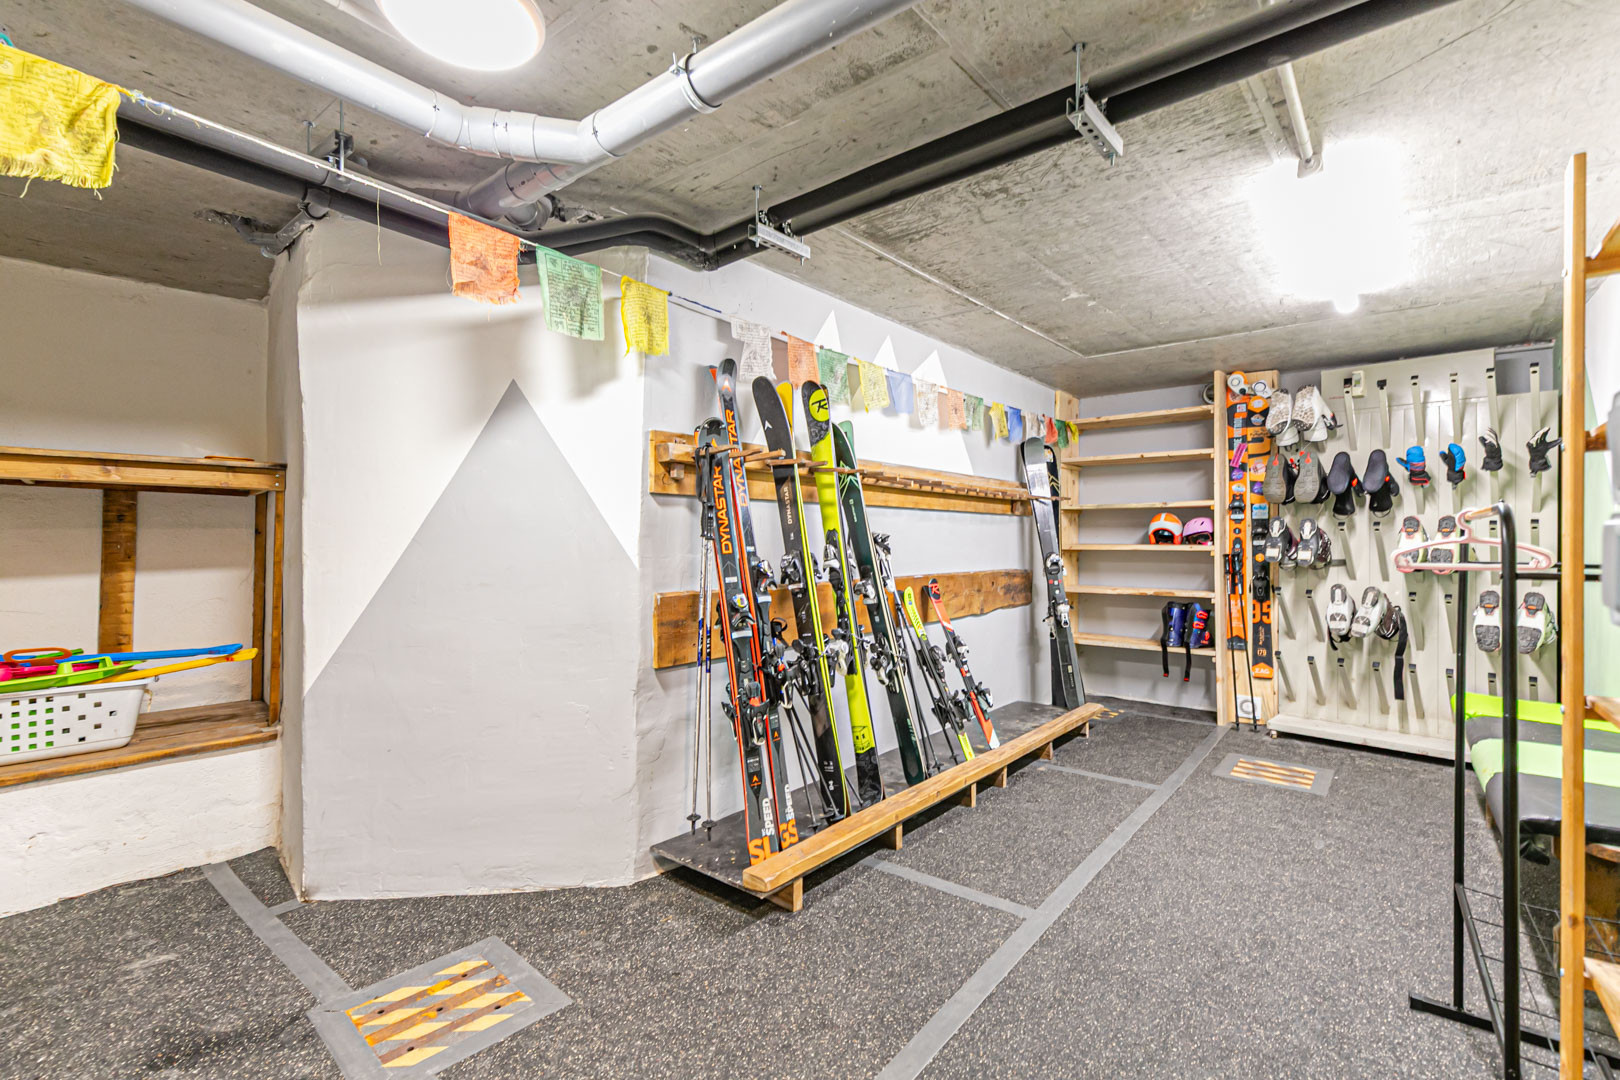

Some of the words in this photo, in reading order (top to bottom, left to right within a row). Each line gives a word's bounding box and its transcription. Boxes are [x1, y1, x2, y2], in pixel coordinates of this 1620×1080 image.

[784, 486, 793, 525] DYNASTAR
[1252, 599, 1272, 624] 95
[762, 798, 775, 836] SPEED
[780, 820, 799, 849] GS
[749, 837, 779, 866] SL
